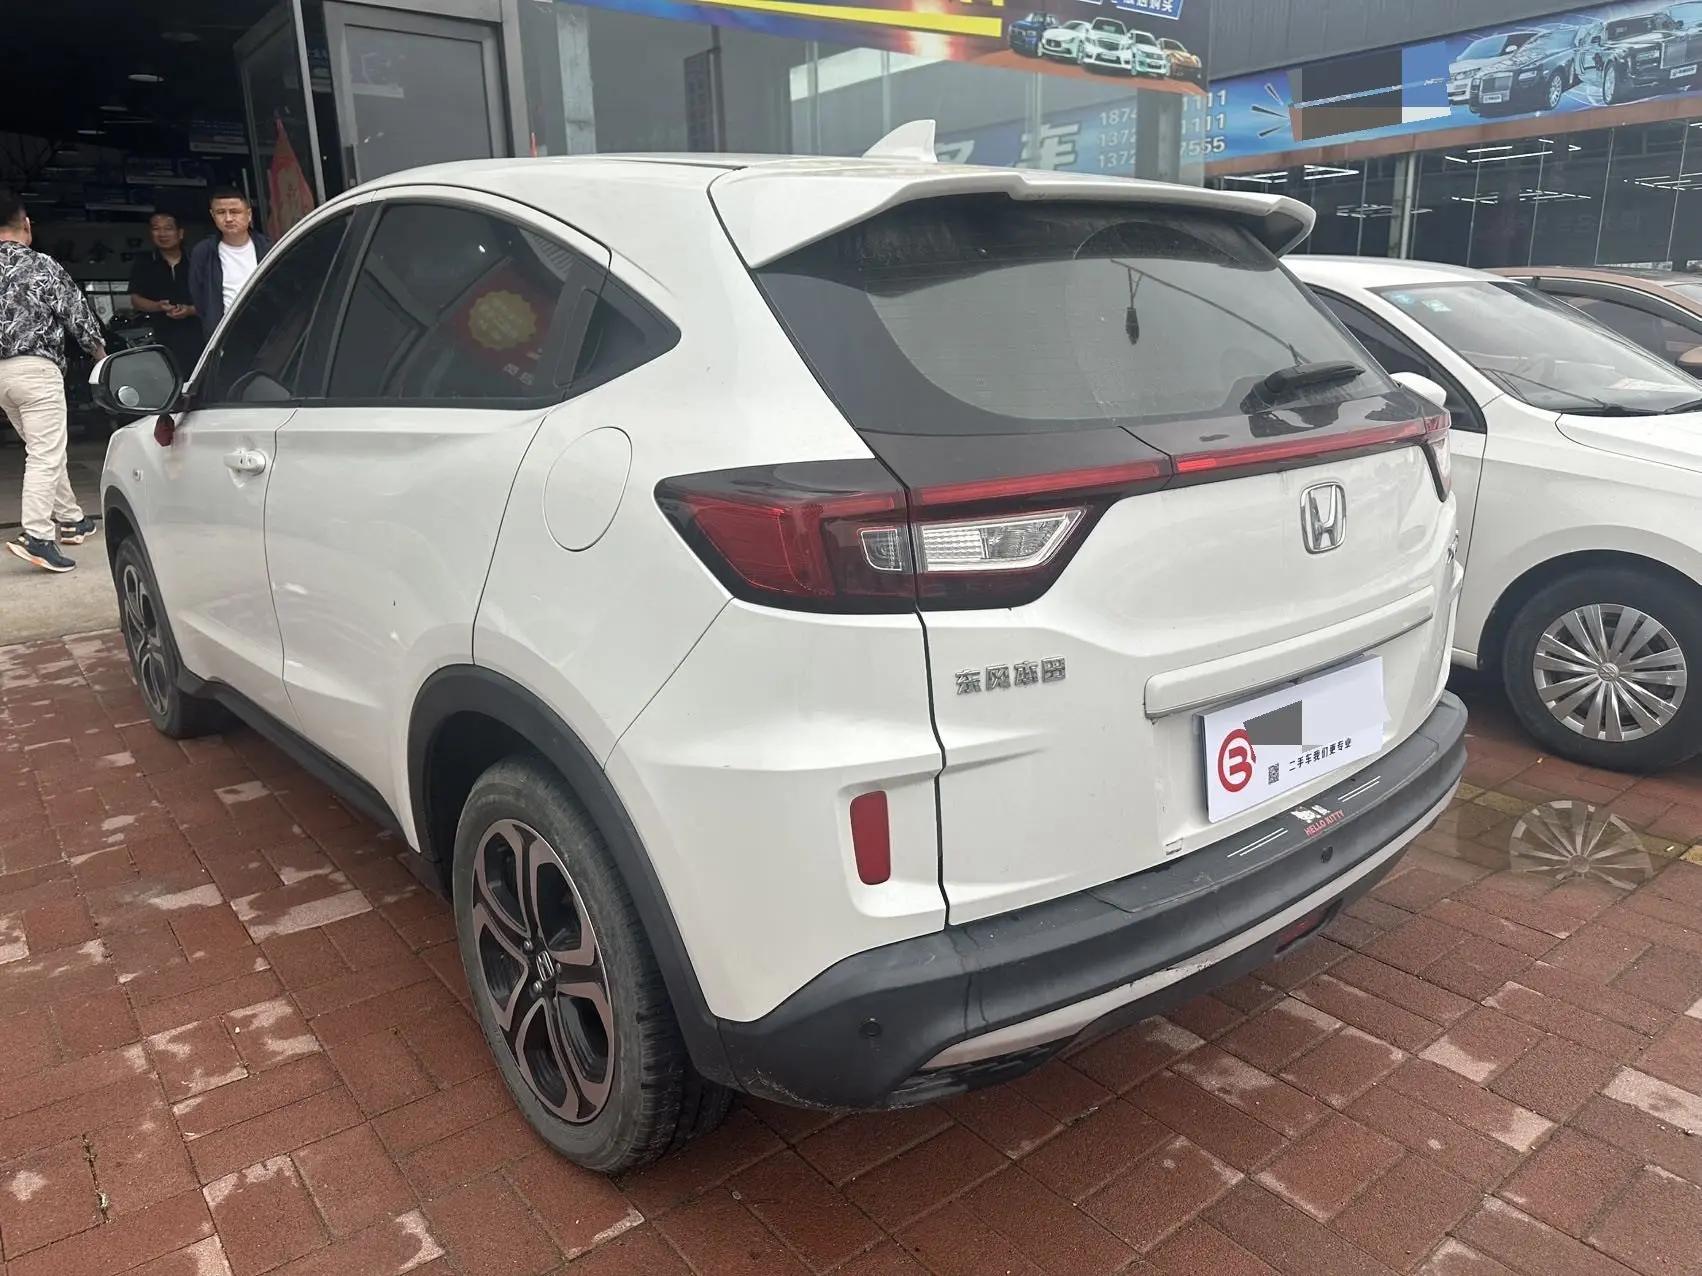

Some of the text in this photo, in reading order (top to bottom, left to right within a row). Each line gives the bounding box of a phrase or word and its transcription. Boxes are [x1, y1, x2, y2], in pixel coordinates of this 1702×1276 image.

[955, 656, 1066, 695] 东风本田
[1289, 737, 1352, 772] 二手车我们更专业
[1304, 809, 1345, 838] HELLO KITTY
